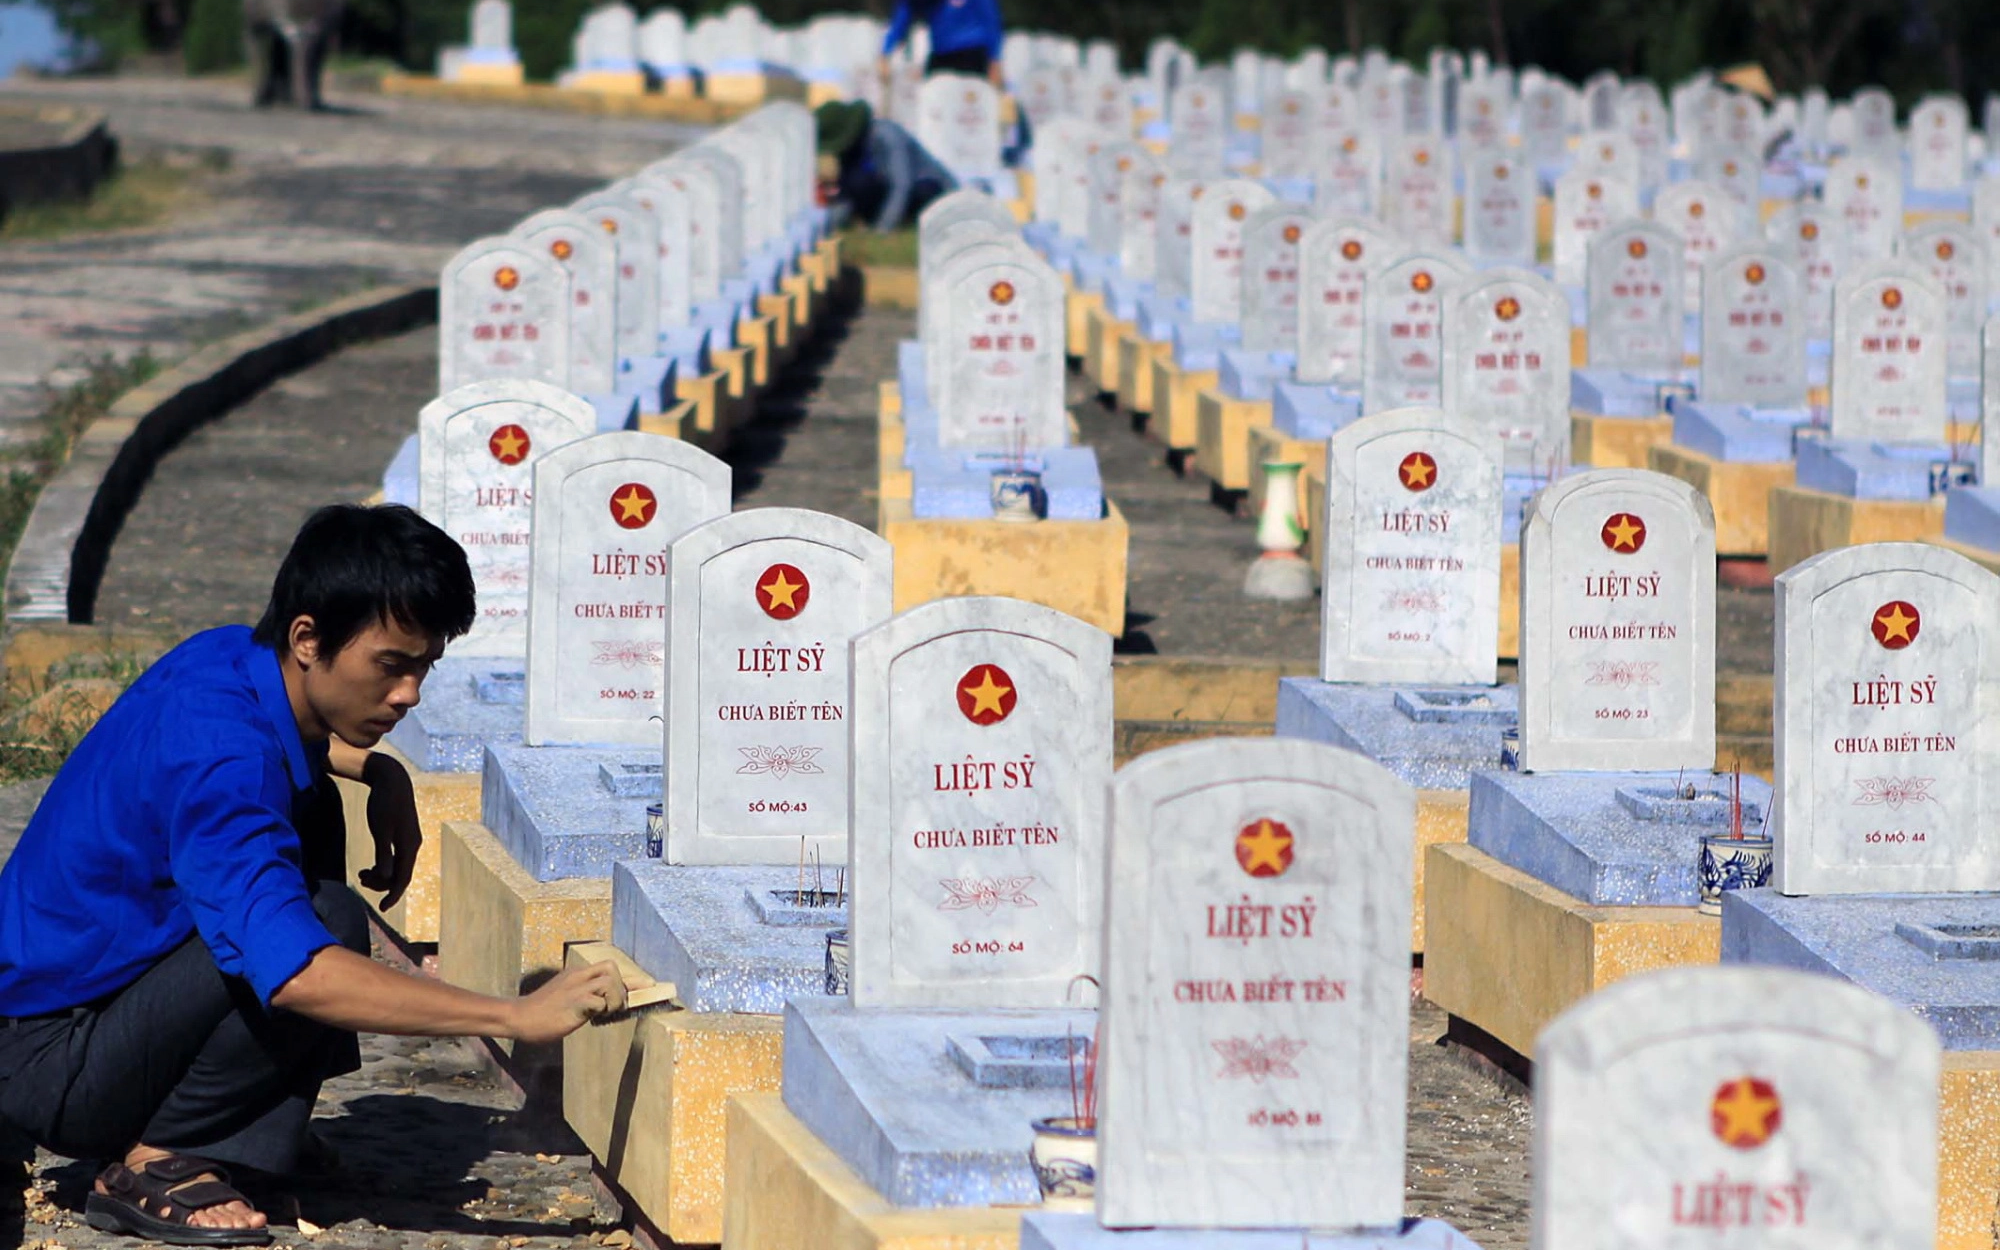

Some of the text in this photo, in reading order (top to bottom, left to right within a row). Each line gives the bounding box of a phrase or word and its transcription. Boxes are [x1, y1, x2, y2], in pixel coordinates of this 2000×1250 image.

[1383, 507, 1424, 536] LIỆT
[592, 548, 640, 580] LIỆT
[1585, 568, 1662, 602] LIỆT SỸ
[575, 604, 617, 619] CHƯA
[620, 600, 653, 619] BIẾT
[1568, 621, 1677, 640] CHƯA BIẾT TÊN
[738, 641, 826, 678] LIỆT SỸ
[600, 686, 615, 700] SỐ
[644, 690, 656, 700] 22
[1853, 674, 1937, 710] LIỆT SỸ
[718, 700, 844, 721] CHƯA BIẾT TÊN
[1595, 707, 1610, 720] SỐ
[1636, 709, 1650, 719] 23
[1834, 732, 1956, 753] CHƯA BIẾT TÊN
[934, 752, 1036, 798] LIỆT SỸ
[748, 799, 765, 813] SỐ
[913, 823, 1059, 850] CHƯA BIẾT TÊN
[1865, 830, 1881, 844] SỐ
[1912, 833, 1926, 843] 44
[1206, 894, 1317, 947] LIỆT SỸ
[952, 936, 1025, 956] SỐ MỘ: 64
[1173, 973, 1346, 1004] CHƯA BIẾT TÊN
